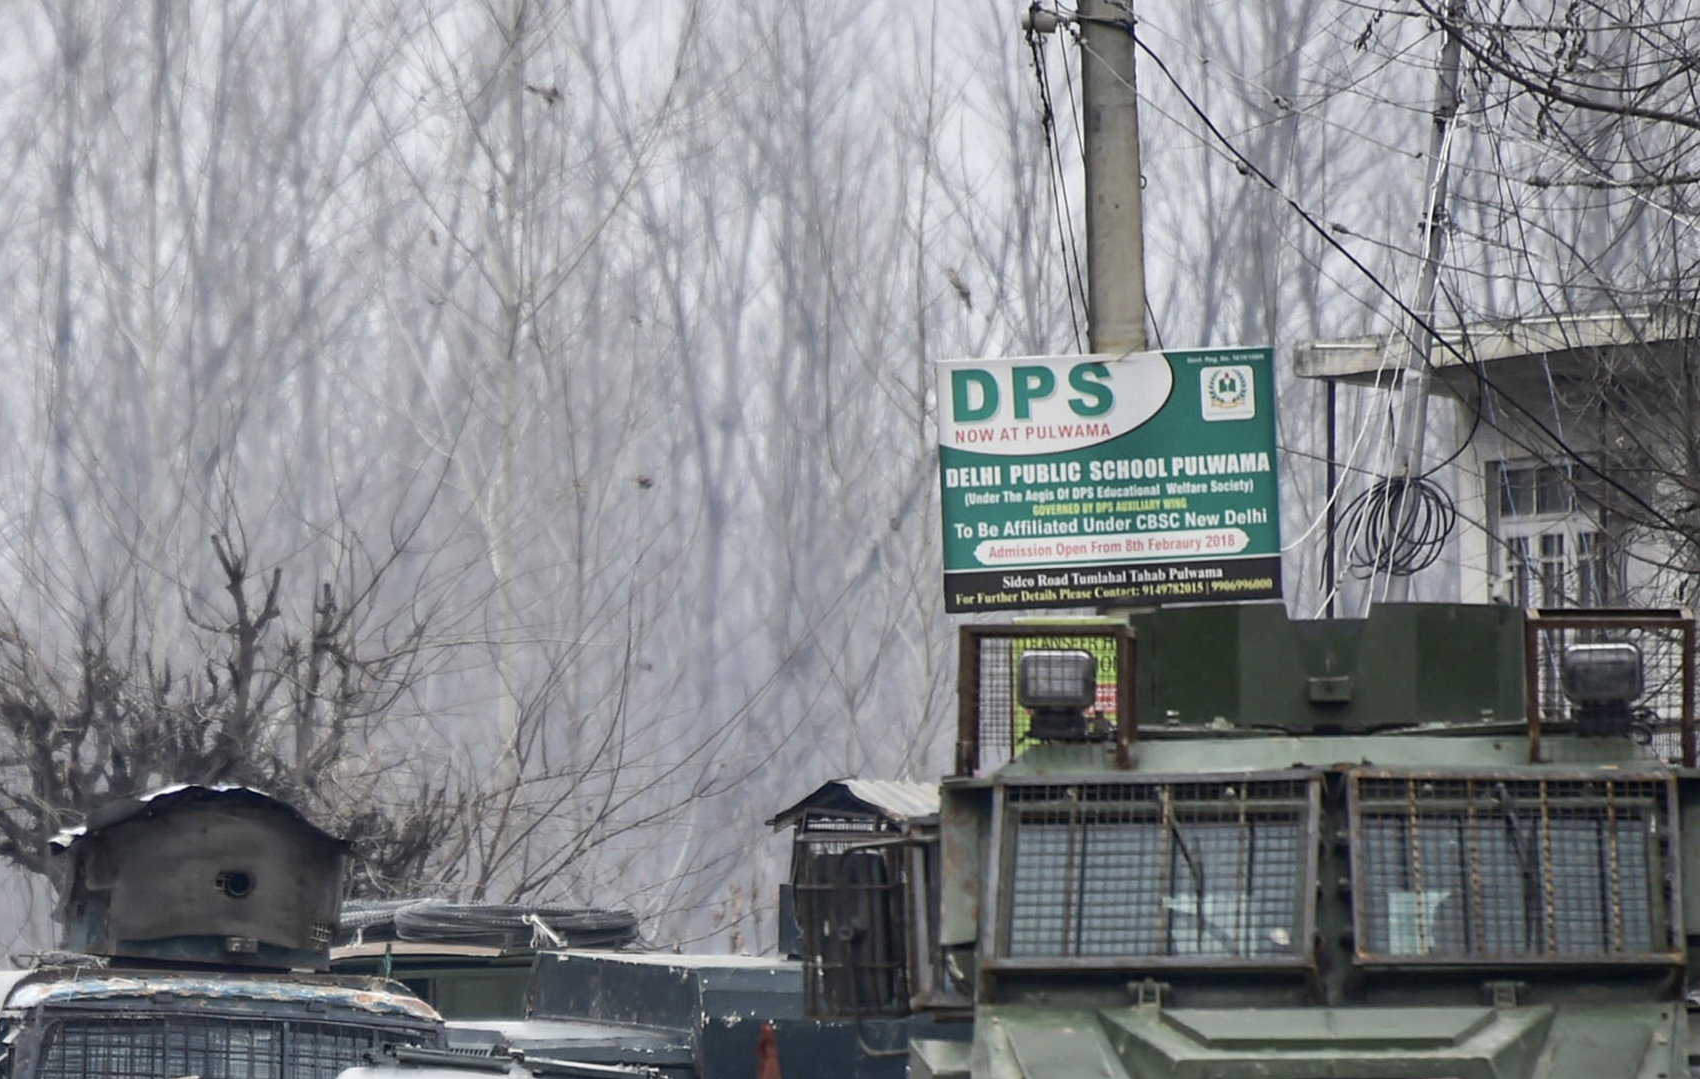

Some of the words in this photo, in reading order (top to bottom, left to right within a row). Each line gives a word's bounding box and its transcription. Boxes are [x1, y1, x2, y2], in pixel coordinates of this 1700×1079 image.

[951, 362, 1115, 423] DPS
[955, 429, 994, 444] NOW
[1000, 427, 1020, 441] AT
[1025, 423, 1112, 440] PULWAMA
[946, 465, 1001, 488] DELHI
[1010, 461, 1081, 485] PUBLIC
[1089, 457, 1168, 481] SCHOOL
[1172, 452, 1271, 477] PULWAMA
[964, 492, 1000, 507] (Under
[1003, 490, 1023, 503] The
[1025, 489, 1055, 503] Aegis
[1057, 487, 1070, 500] Of
[1072, 486, 1094, 499] DPS
[1097, 483, 1160, 498] Educational
[1166, 481, 1208, 495] Welfare
[1210, 478, 1254, 493] Society)
[1032, 503, 1080, 517] GOVERNED
[1082, 502, 1093, 515] BY
[1096, 501, 1114, 513] DPS
[1163, 497, 1188, 510] WING
[954, 523, 973, 539] To
[978, 522, 999, 538] Be
[1003, 518, 1078, 536] Affiliated
[1083, 515, 1132, 533] Under
[1136, 512, 1181, 529] CBSC
[1185, 511, 1220, 528] New
[1225, 508, 1268, 525] Delhi
[988, 544, 1053, 558] Admission
[1056, 543, 1087, 558] Open
[1091, 540, 1122, 554] From
[1125, 538, 1144, 551] 8th
[1148, 537, 1202, 553] Febraury
[1205, 534, 1236, 548] 2018
[1002, 575, 1035, 589] Sidco
[1037, 573, 1069, 587] Road
[1071, 571, 1127, 586] Tumlahal
[1129, 568, 1167, 583] Tahab
[1169, 566, 1224, 581] Pulwama
[955, 594, 975, 605] For
[977, 591, 1019, 604] Further
[1021, 590, 1057, 602] Details
[1060, 588, 1092, 600] Please
[1094, 586, 1140, 598] Contact:
[1142, 581, 1204, 596] 9149782015
